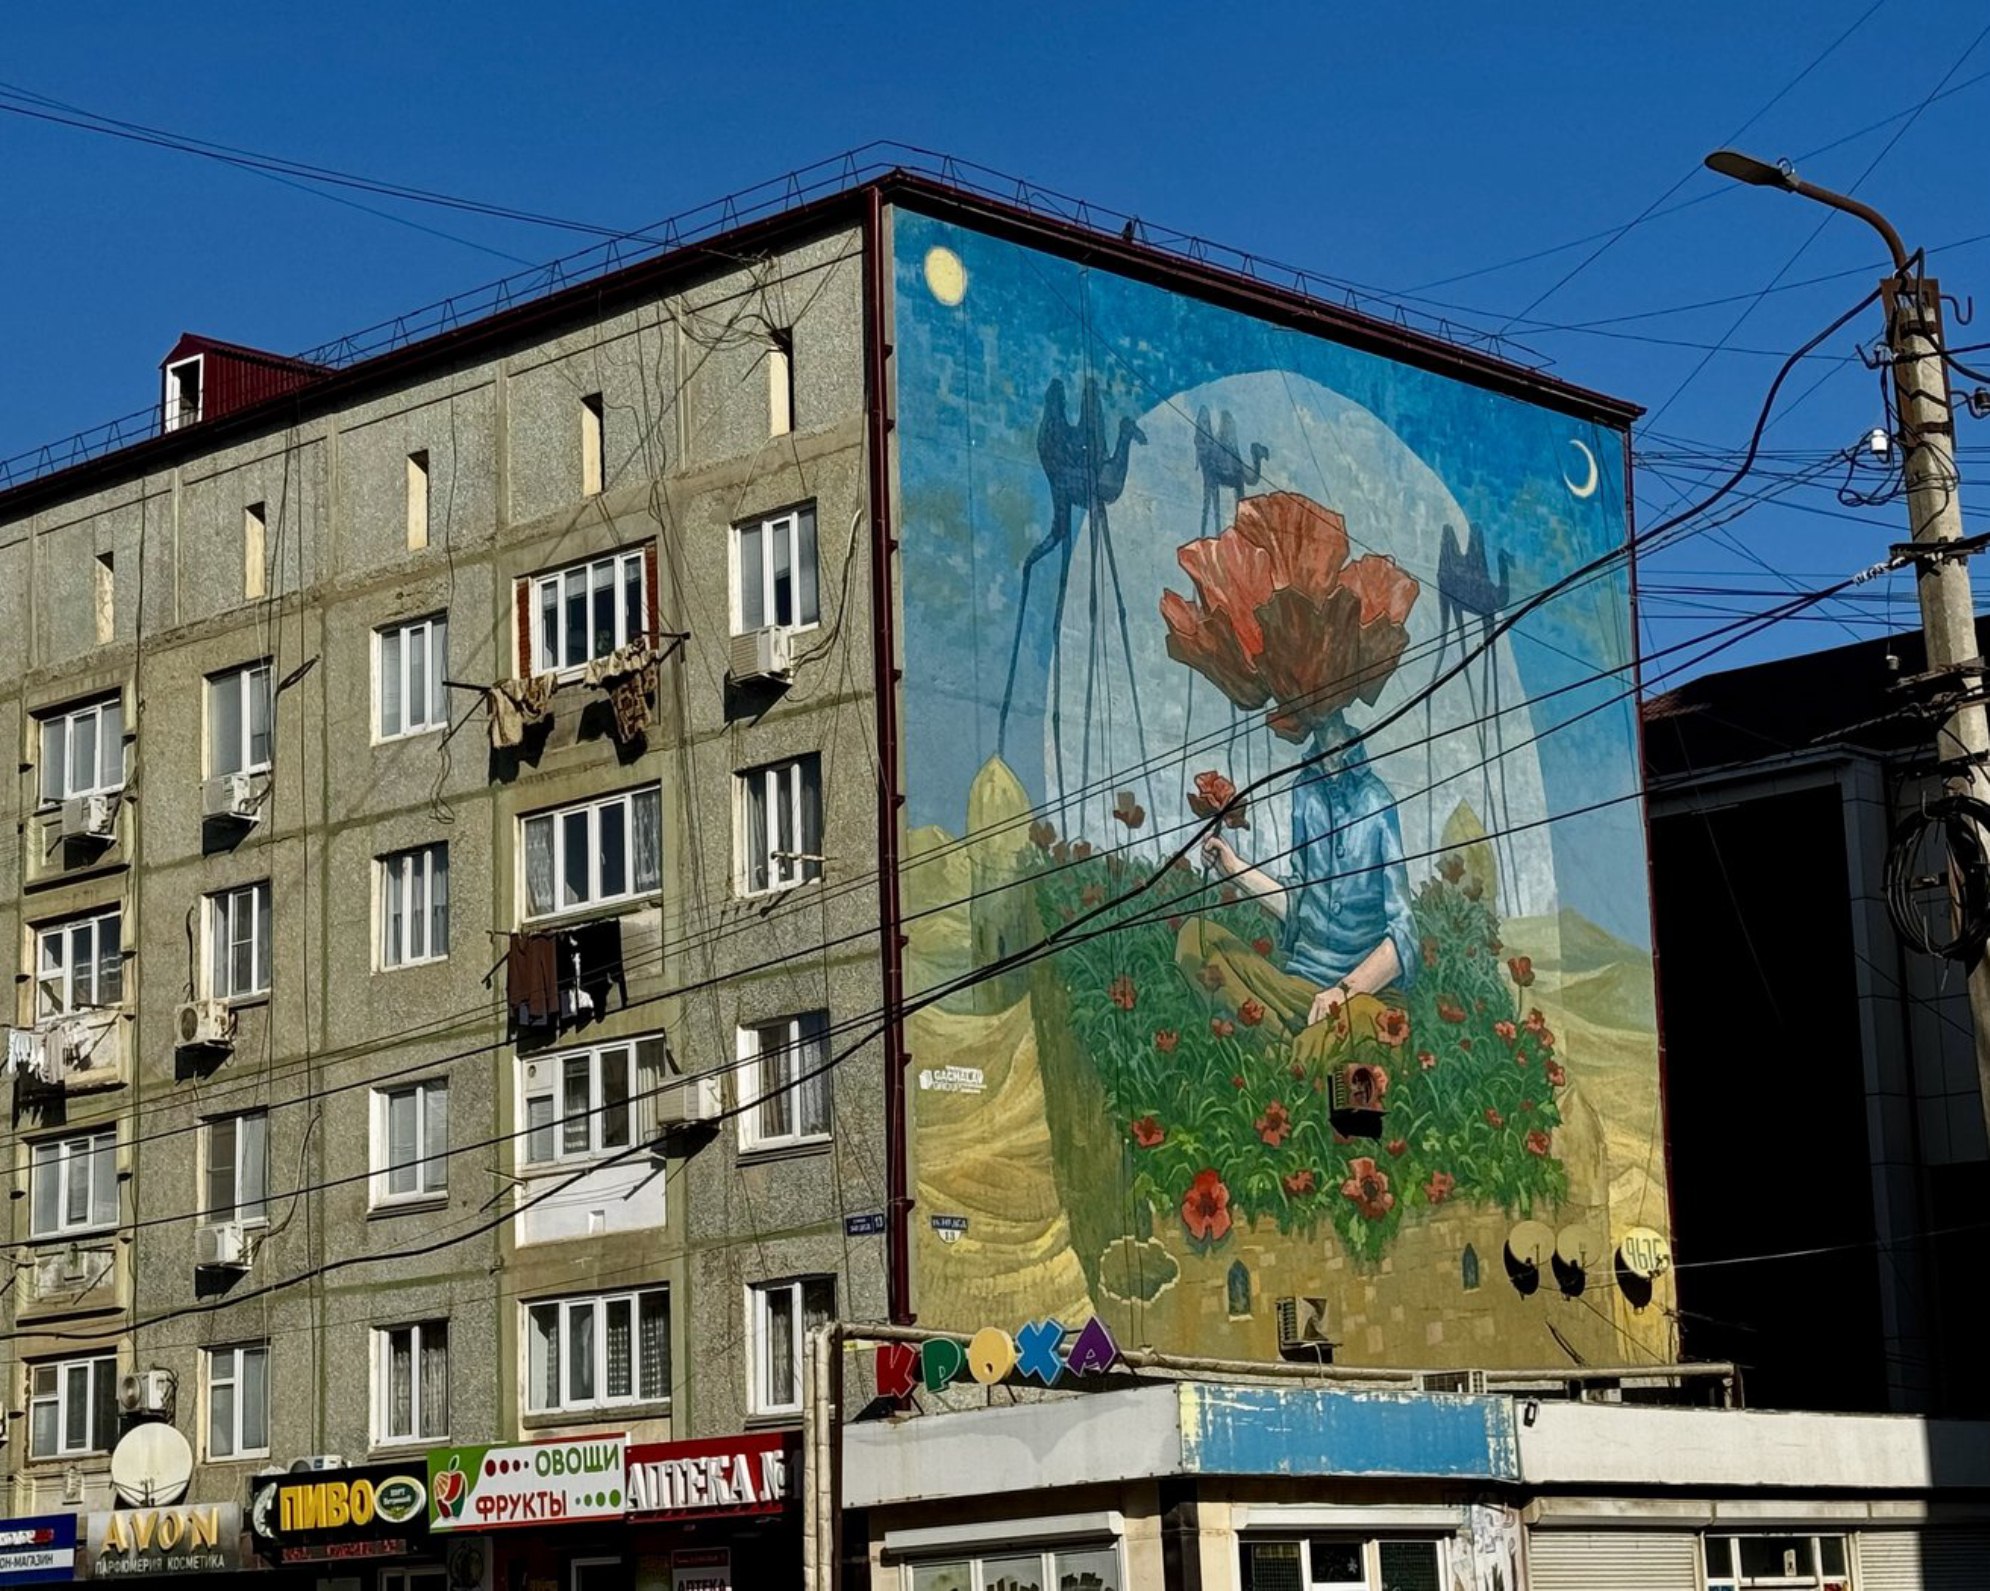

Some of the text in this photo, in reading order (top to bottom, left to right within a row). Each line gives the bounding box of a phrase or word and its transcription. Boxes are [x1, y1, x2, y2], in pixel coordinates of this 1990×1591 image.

[876, 1314, 1119, 1398] КРОХА
[535, 1443, 619, 1477] ОВОЩИ
[626, 1454, 757, 1512] АПТЕКА
[280, 1478, 375, 1531] ПИВО
[475, 1489, 567, 1522] ФРУКТЫ
[101, 1507, 218, 1554] AVON
[95, 1553, 225, 1576] ПАРФЮМЕРИЯ КОСМЕТИКА
